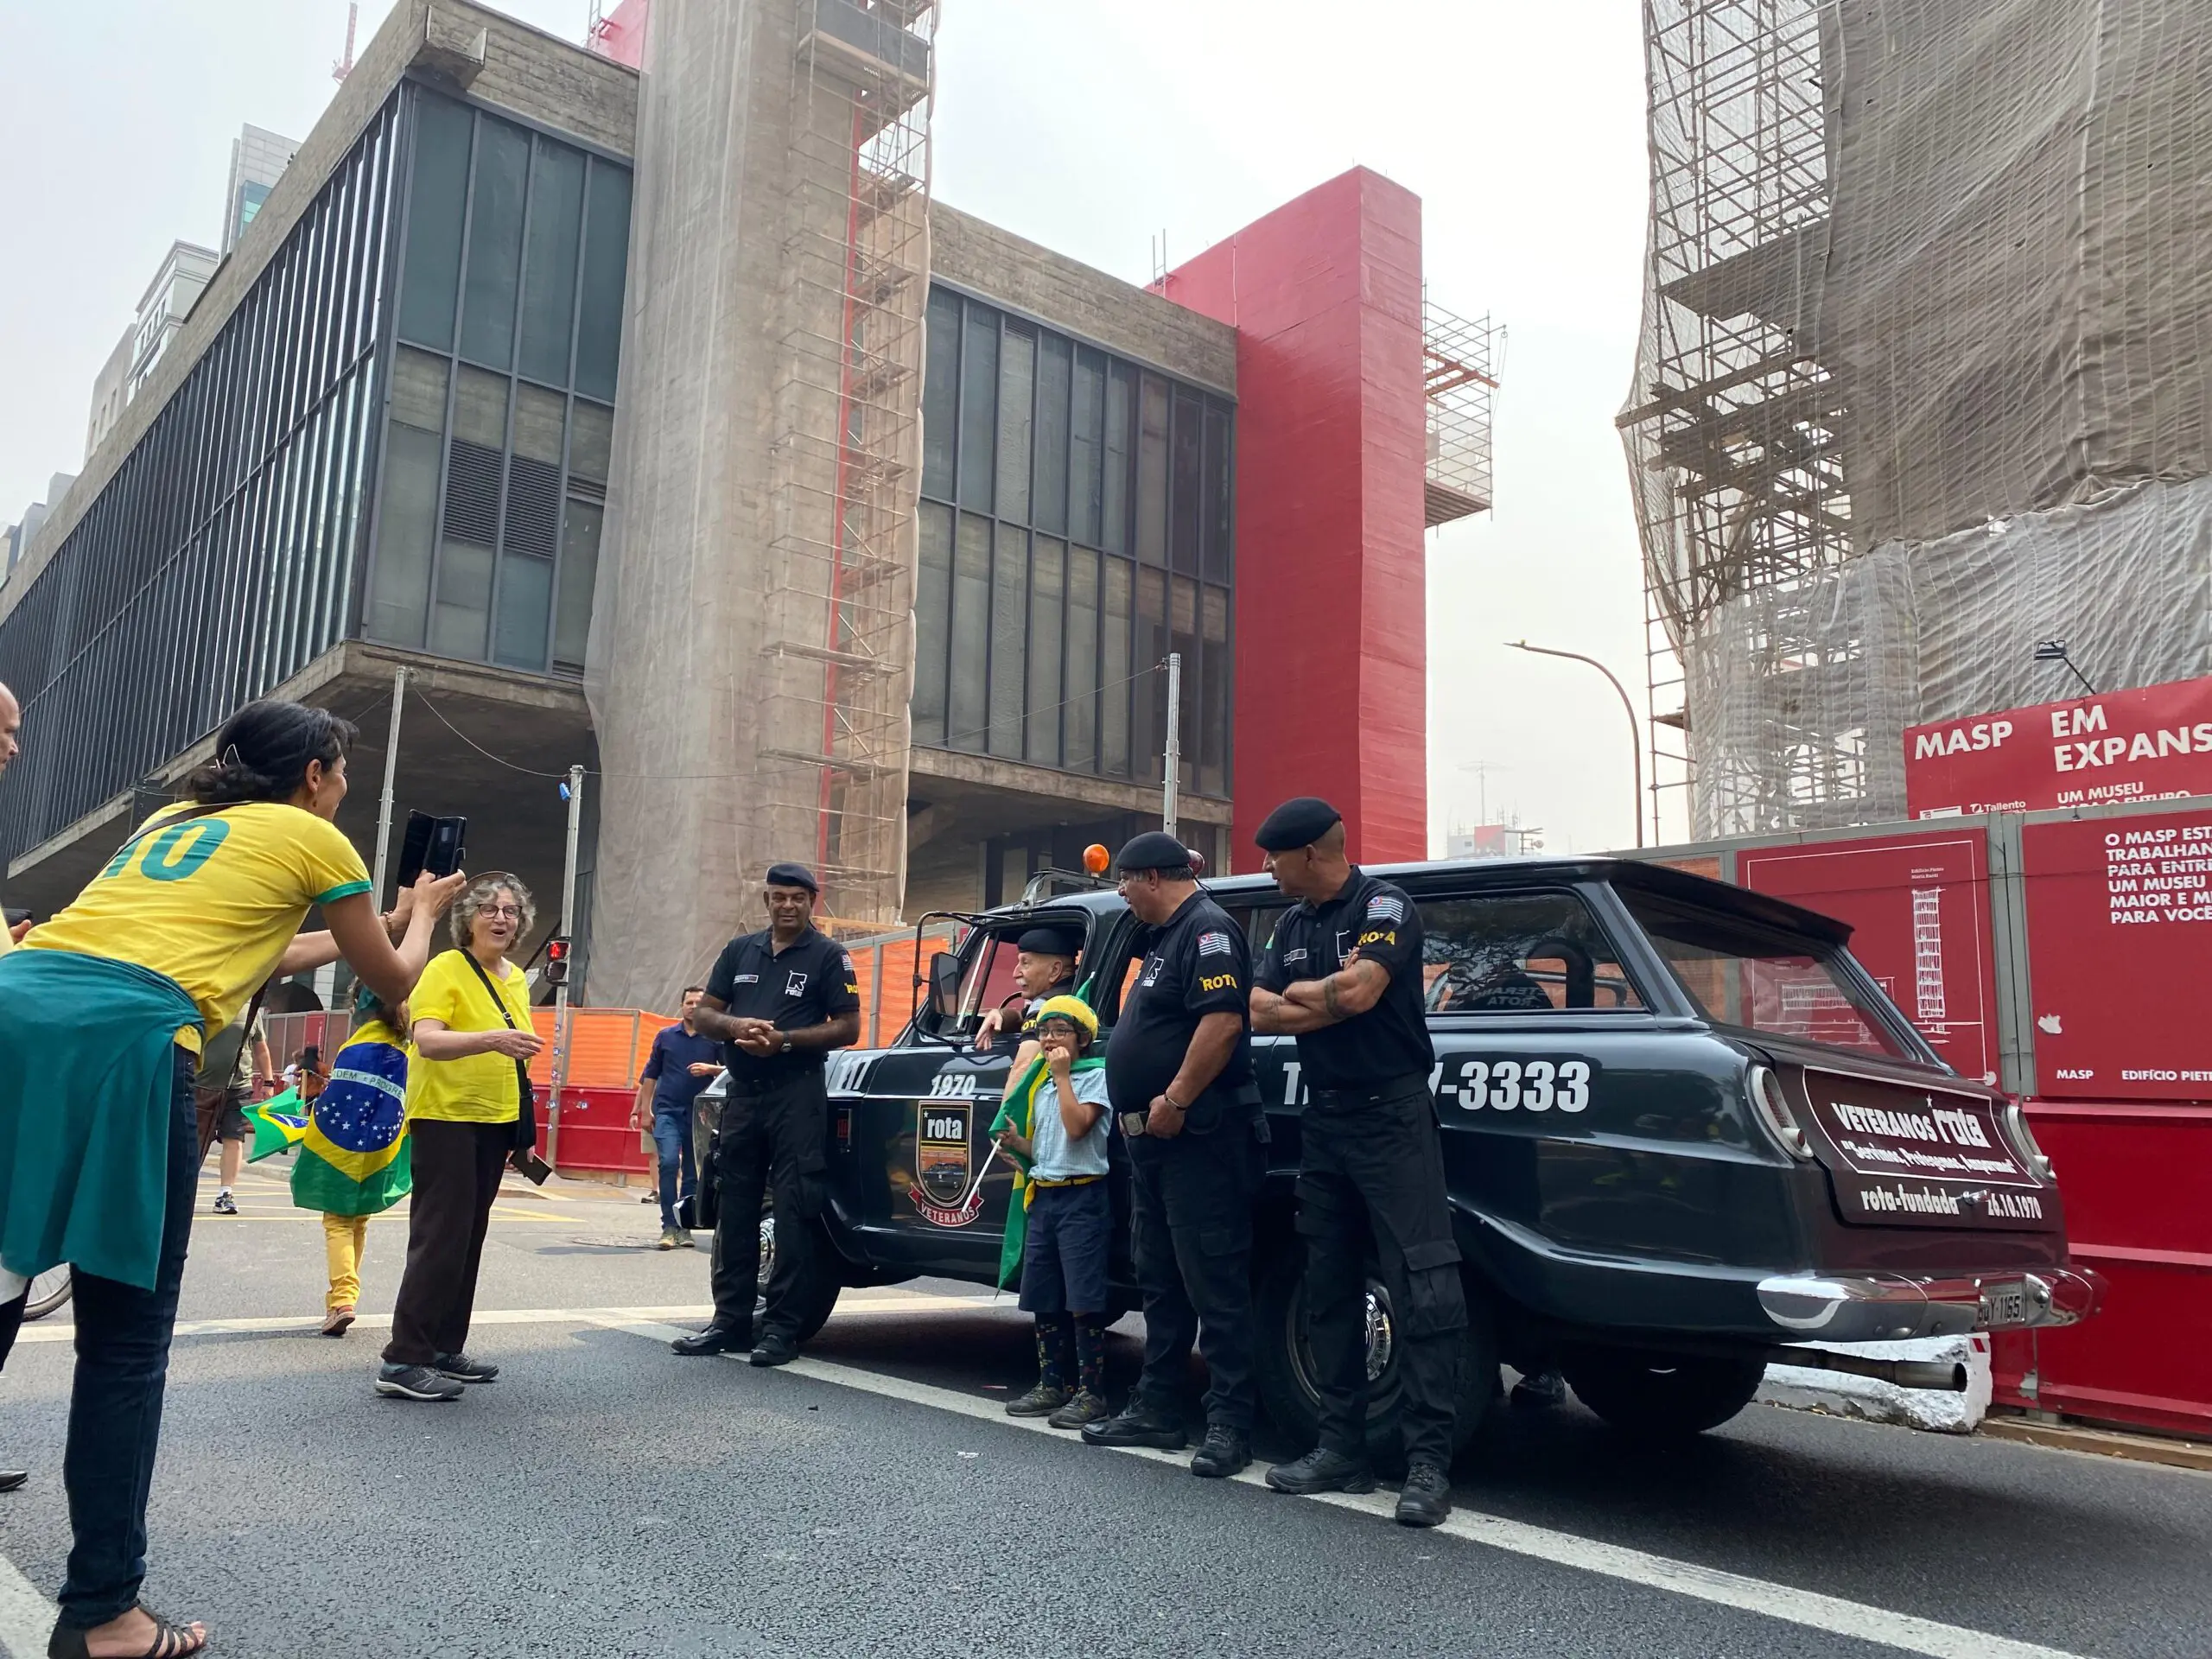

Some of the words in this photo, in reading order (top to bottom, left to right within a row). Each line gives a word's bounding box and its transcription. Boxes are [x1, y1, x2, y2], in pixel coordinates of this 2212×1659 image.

[2051, 705, 2107, 738] EM
[1915, 721, 2013, 760] MASP
[2057, 790, 2084, 804] UM
[2088, 781, 2144, 800] MUSEU
[2105, 833, 2120, 846] O
[2126, 829, 2177, 844] MASP
[2107, 862, 2156, 877] PARA
[2108, 880, 2138, 893] UM
[2143, 874, 2206, 891] MUSEU
[2110, 893, 2172, 908] MAIOR
[2177, 892, 2187, 905] E
[2111, 910, 2159, 924] PARA
[2056, 1069, 2094, 1079] MASP
[931, 1074, 976, 1096] 1970
[927, 1117, 963, 1140] rota
[1831, 1102, 1938, 1142] VETERANOS
[921, 1203, 976, 1224] VETERANOS
